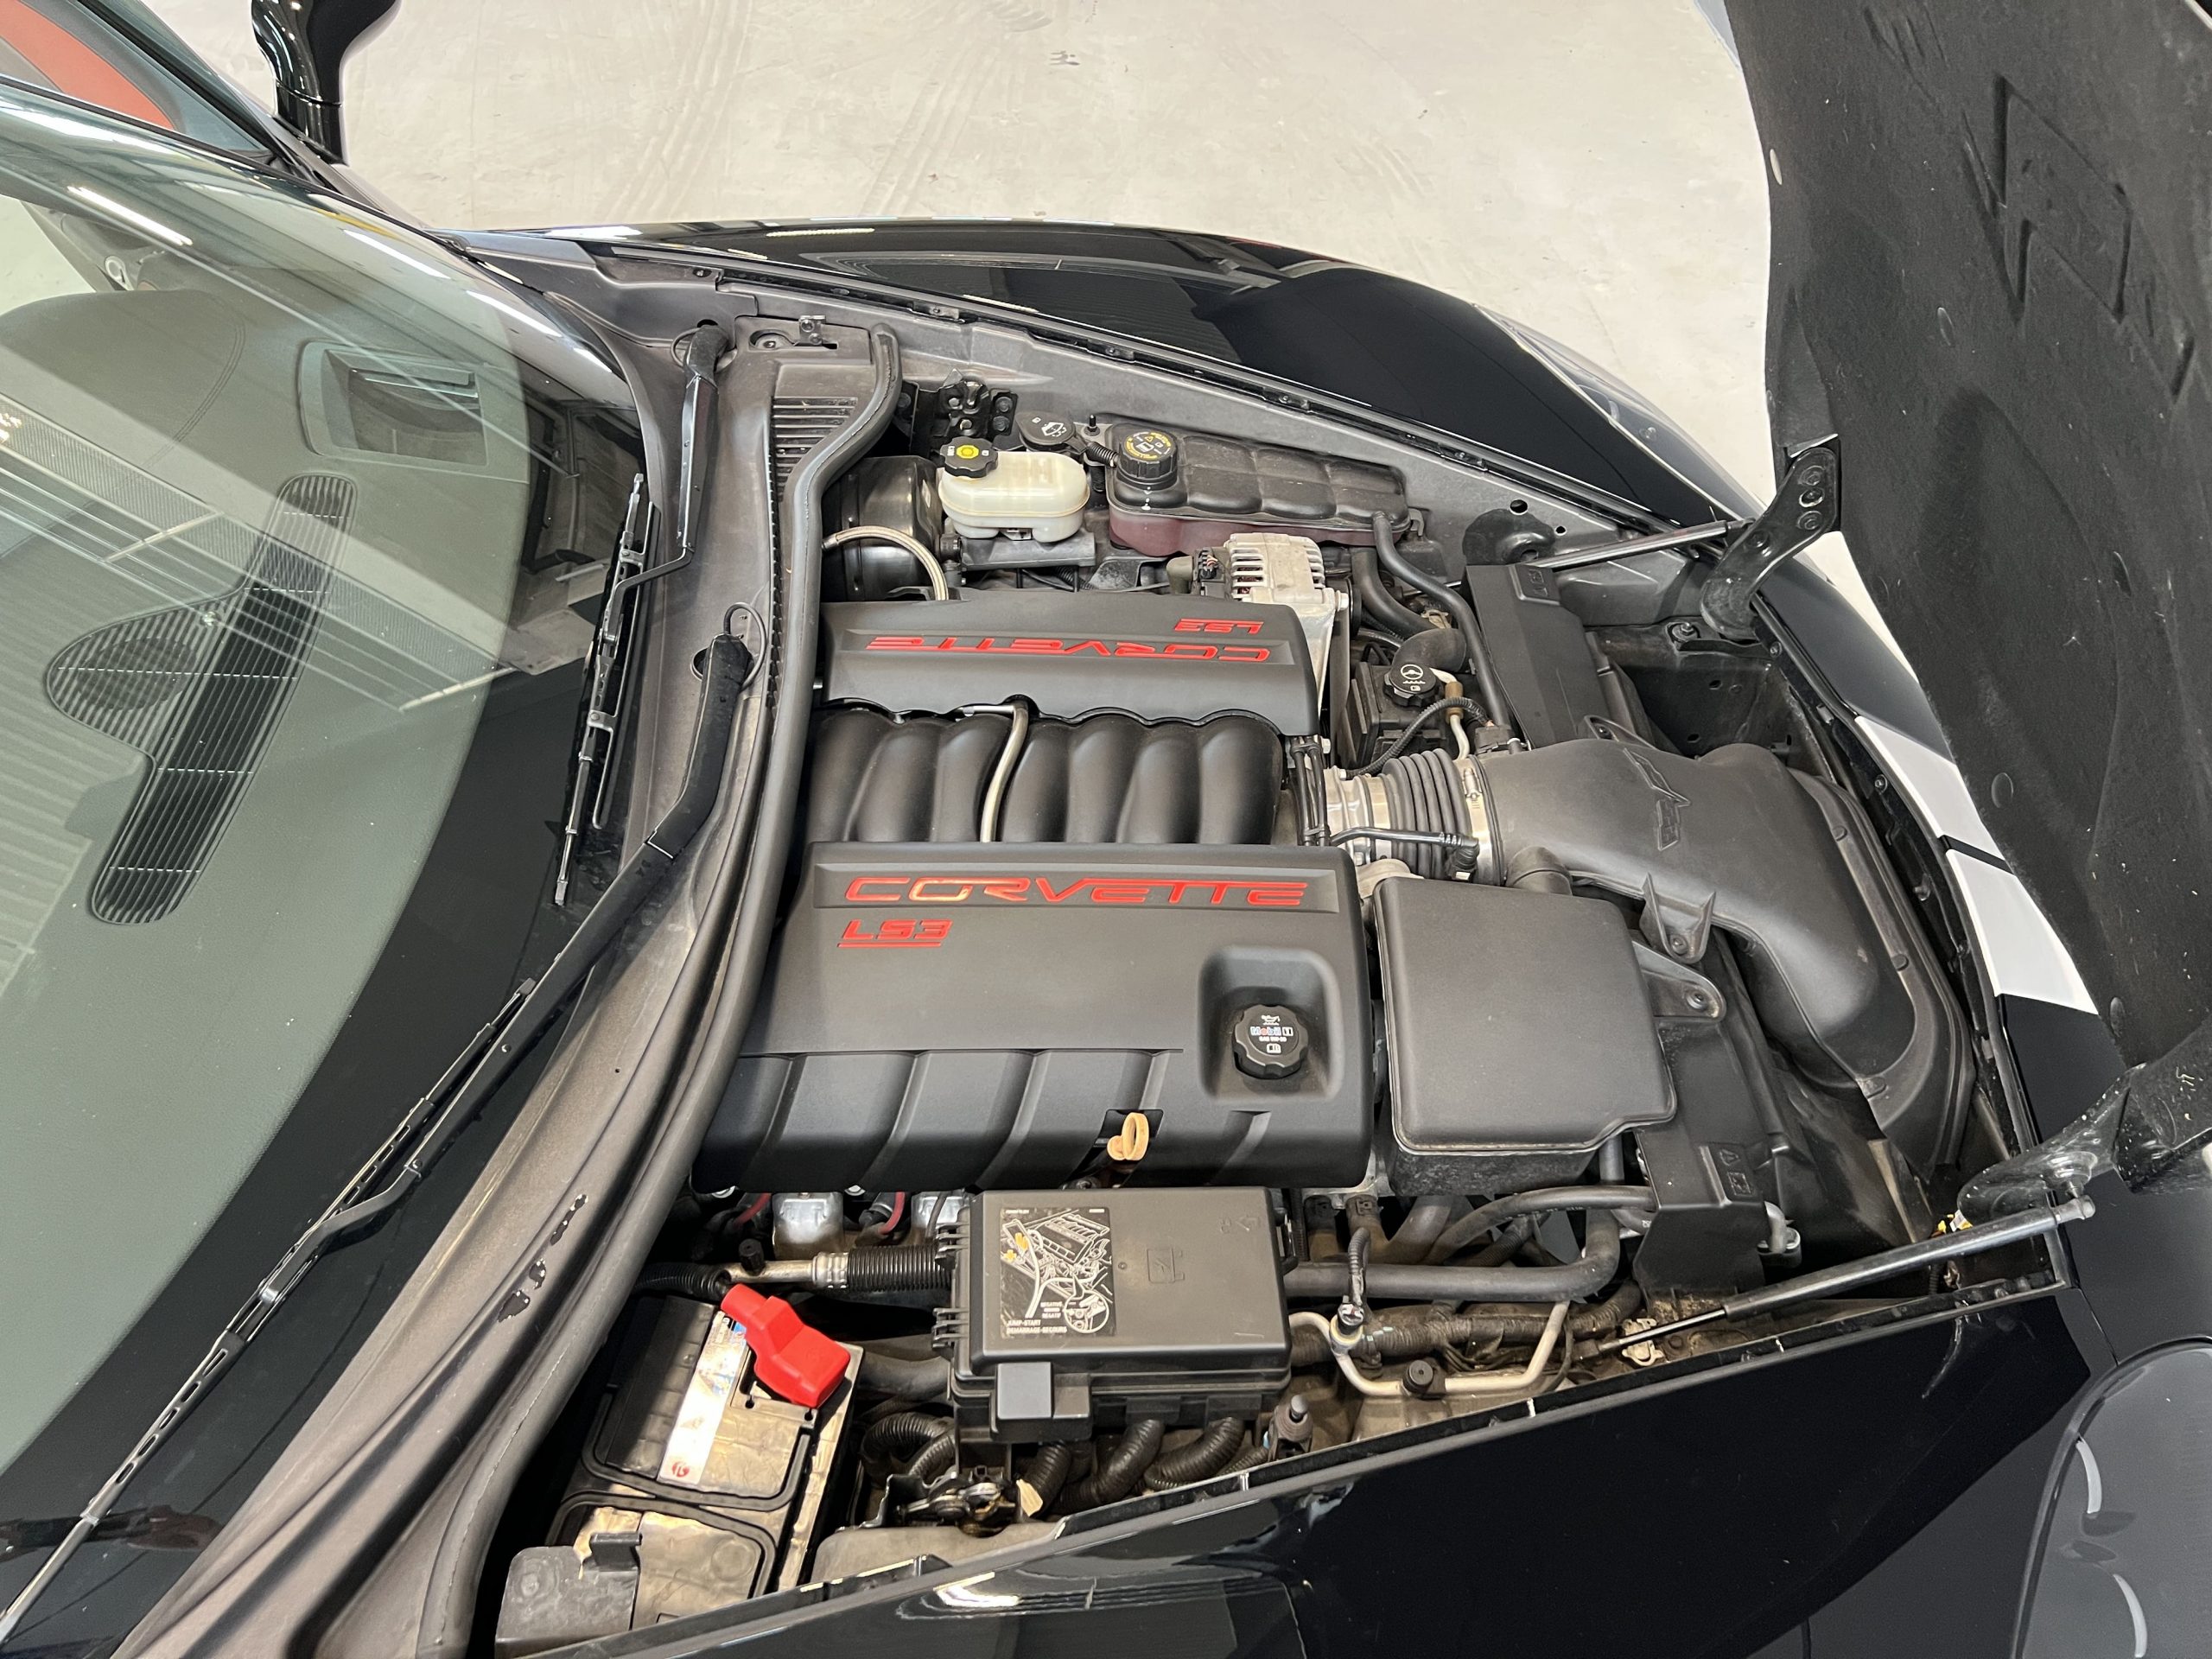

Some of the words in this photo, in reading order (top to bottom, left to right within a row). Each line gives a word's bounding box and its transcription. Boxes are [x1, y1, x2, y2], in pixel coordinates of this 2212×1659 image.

[1173, 618, 1265, 633] LS3
[865, 636, 1271, 663] CORVETTE
[844, 876, 1308, 906] CORVETTE
[841, 918, 953, 941] LS3
[1250, 1027, 1281, 1036] Mobil
